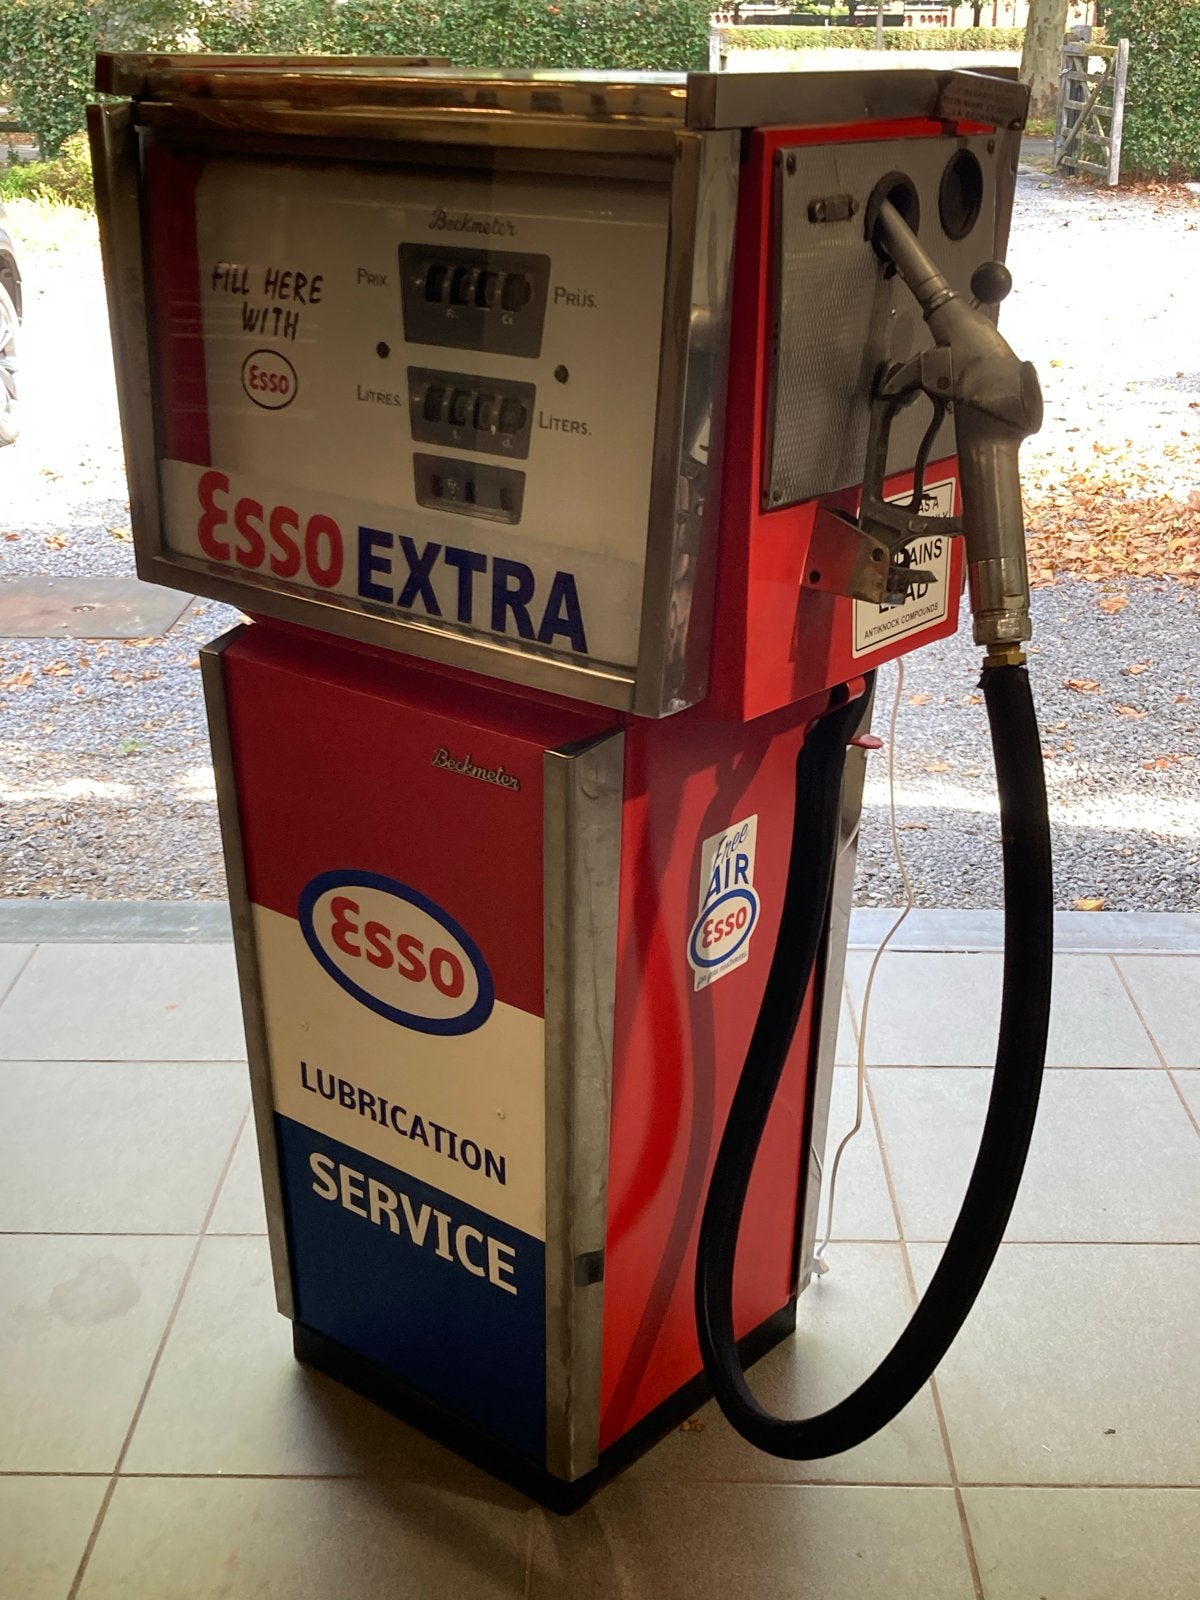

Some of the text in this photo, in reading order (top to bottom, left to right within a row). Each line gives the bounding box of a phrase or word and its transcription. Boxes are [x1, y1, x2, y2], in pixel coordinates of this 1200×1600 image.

[428, 208, 517, 236] Beckmeter
[212, 261, 324, 305] FILL HERE
[242, 301, 299, 341] WITH
[249, 365, 289, 395] ESSO
[198, 470, 589, 654] ESSO EXTRA
[864, 602, 938, 639] ANTIKNOCK COMPOUNDS
[431, 747, 520, 791] Beckmeter
[713, 823, 748, 871] Free
[702, 853, 749, 912] AIR
[329, 896, 465, 1000] ESSO
[701, 906, 747, 949] ESSO
[300, 1061, 507, 1186] LUBRICATION
[309, 1152, 518, 1295] SERVICE
